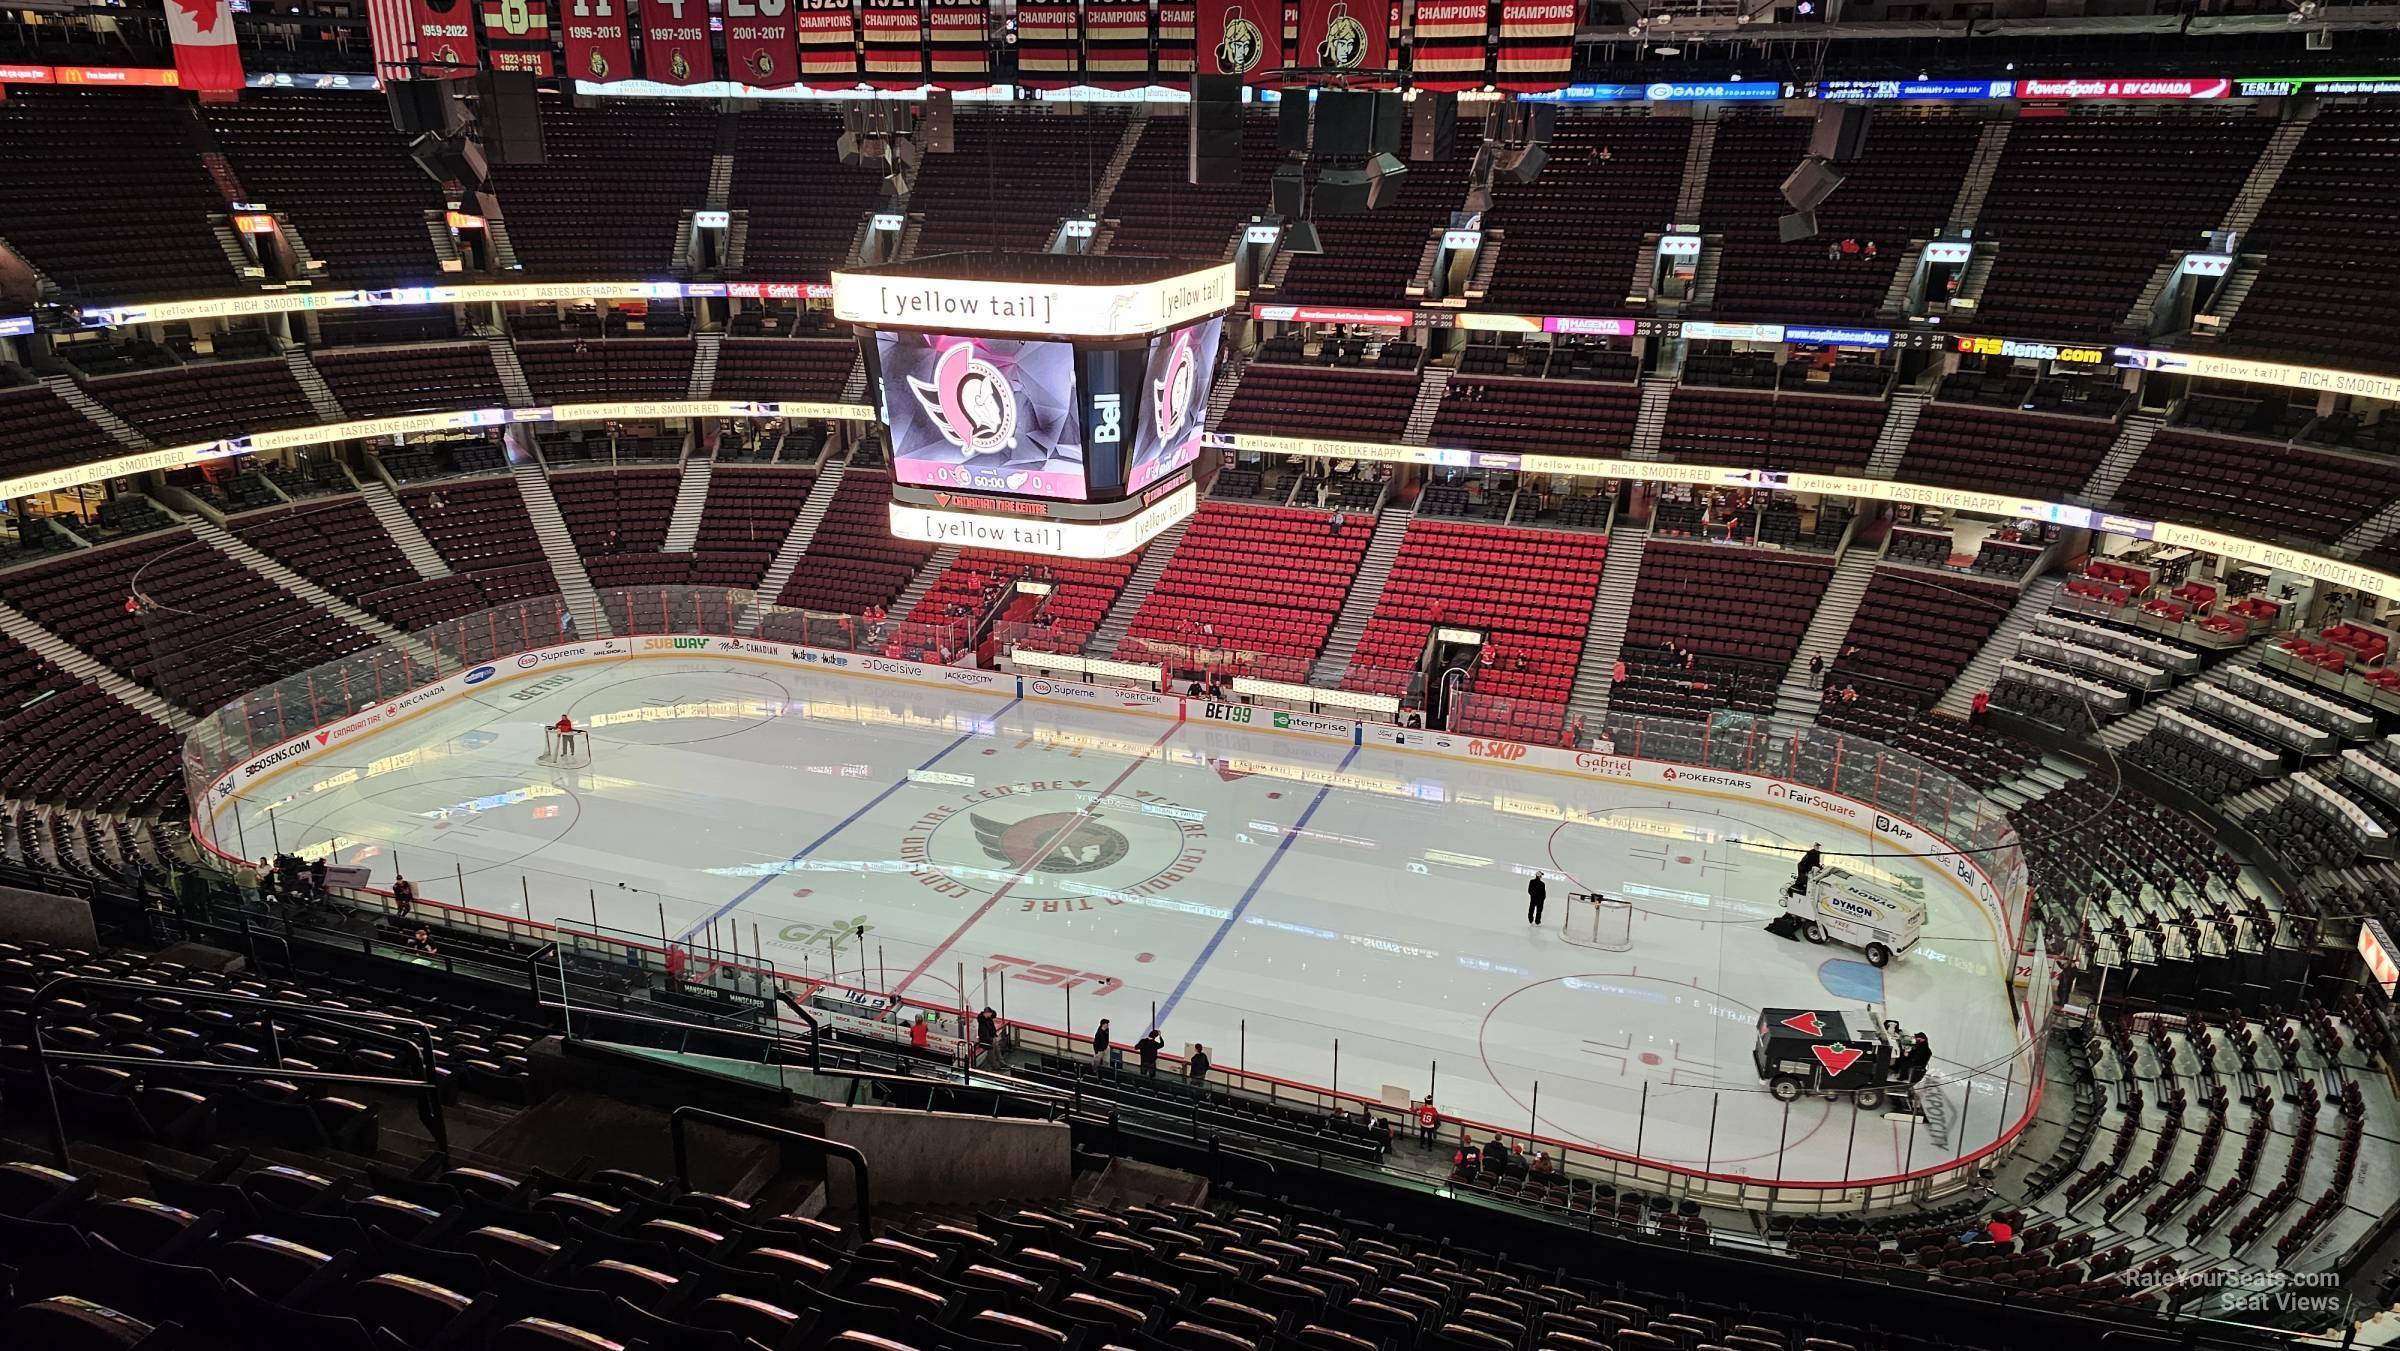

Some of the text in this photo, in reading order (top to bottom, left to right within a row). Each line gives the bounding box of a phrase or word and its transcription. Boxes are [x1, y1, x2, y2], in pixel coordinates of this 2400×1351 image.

[931, 13, 987, 25] CHAMPIONS
[1019, 11, 1076, 24] CHAMPIONS
[1088, 10, 1146, 23] CHAMPIONS
[1417, 5, 1486, 20] CHAMPIONS
[1503, 5, 1574, 19] CHAMPIONS
[800, 16, 851, 28] CHAMPIONS
[865, 14, 918, 26] CHAMPIONS
[422, 25, 468, 37] 1959-2022
[569, 26, 622, 39] 1995-2013
[650, 28, 702, 40] 1997-2015
[732, 27, 786, 40] 2001-2017
[2026, 81, 2191, 97] PowerSports & RV CANADA
[2242, 82, 2290, 93] TERLIN
[536, 286, 623, 297] TASTES LIKE HAPPY
[233, 296, 327, 313] RICH, SMOOTH RED
[1570, 320, 1620, 329] MAGENTA
[1787, 328, 1890, 345] www.capitalsecurity.ca
[1894, 332, 1908, 340] 310
[1893, 340, 1907, 348] 210
[2299, 371, 2392, 396] RICH, SMOOTH
[634, 404, 660, 415] RICH,
[662, 403, 699, 414] SMOOTH
[701, 403, 719, 413] RED
[1095, 394, 1121, 444] Bell
[339, 417, 436, 437] TASTES LIKE HAPPY
[1312, 444, 1346, 456] TASTES
[1348, 446, 1368, 456] LIKE
[1370, 447, 1402, 459] HAPPY
[88, 451, 184, 480] RICH, SMOOTH RED
[1611, 464, 1639, 476] RICH,
[1642, 465, 1687, 479] SMOOTH
[1689, 469, 1711, 481] RED
[937, 468, 948, 481] 0
[974, 476, 1005, 488] 60:00
[1032, 477, 1043, 489] 0
[952, 495, 1048, 514] CANADIAN TIRE CENTRE
[1889, 486, 1932, 502] TASTES
[1935, 491, 1960, 505] LIKE
[1962, 494, 2004, 511] HAPPY
[2263, 550, 2296, 568] RICH,
[2301, 558, 2356, 584] SMOOTH
[2359, 572, 2384, 591] RED
[644, 637, 709, 649] SUBWAY
[746, 643, 778, 656] CANADIAN
[541, 647, 585, 662] Supreme
[873, 659, 922, 676] Decisive
[944, 671, 993, 685] JACKPOTCITY
[509, 675, 574, 701] BET99
[1035, 683, 1049, 691] Esso
[1054, 685, 1095, 698] Supreme
[398, 685, 446, 710] AIR CANADA
[1205, 703, 1252, 723] BET99
[333, 713, 382, 739] CANADIAN TIRE
[1278, 716, 1347, 732] enterprise
[245, 739, 311, 778] 5050SENS.COM
[1485, 742, 1527, 761] SKIP
[1575, 752, 1632, 771] Gabriel
[1592, 767, 1632, 778] PIZZA
[218, 776, 235, 798] Bell
[1678, 771, 1752, 790] POKERSTARS
[1789, 789, 1856, 818] FairSquare
[910, 805, 957, 832] TIRE
[1957, 860, 1975, 887] Bell
[1020, 898, 1094, 913] TIRE
[1848, 887, 1897, 910] DYMON
[1832, 898, 1873, 918] DYMON
[779, 922, 862, 952] GFL
[985, 954, 1123, 997] TSN
[684, 984, 718, 998] MANSCAPED
[729, 994, 764, 1008] MANSCAPED
